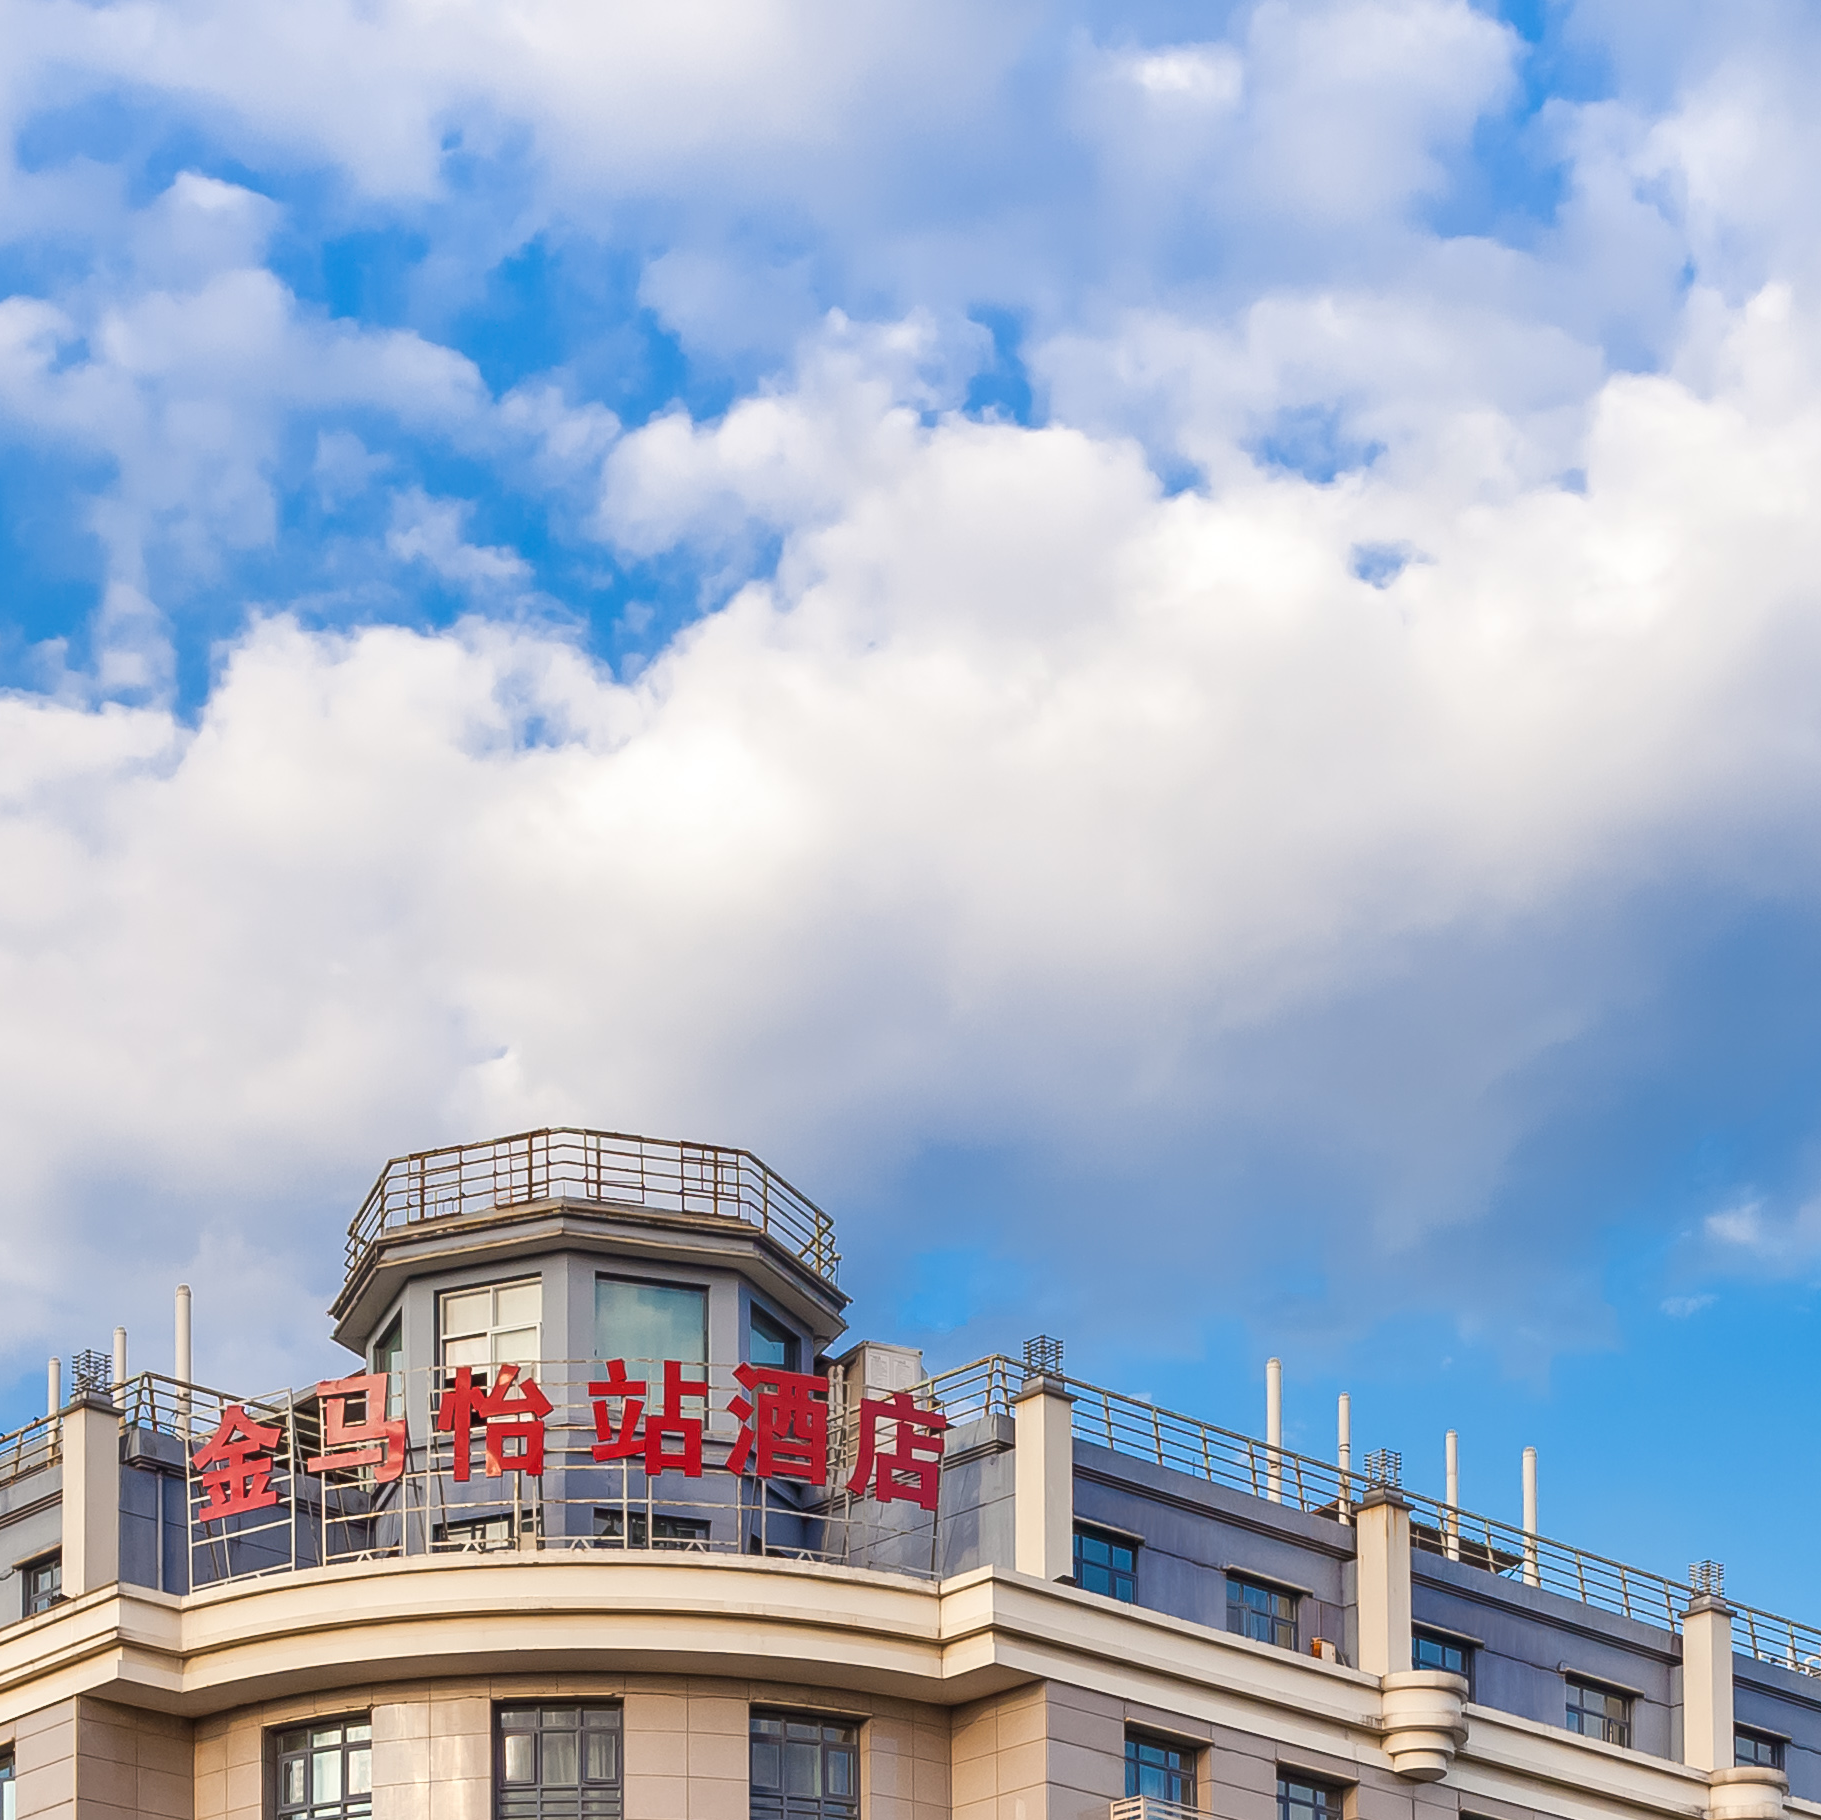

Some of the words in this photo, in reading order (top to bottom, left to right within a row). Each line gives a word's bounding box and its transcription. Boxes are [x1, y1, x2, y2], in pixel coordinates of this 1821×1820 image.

[191, 1358, 948, 1522] 金马怡站酒店
